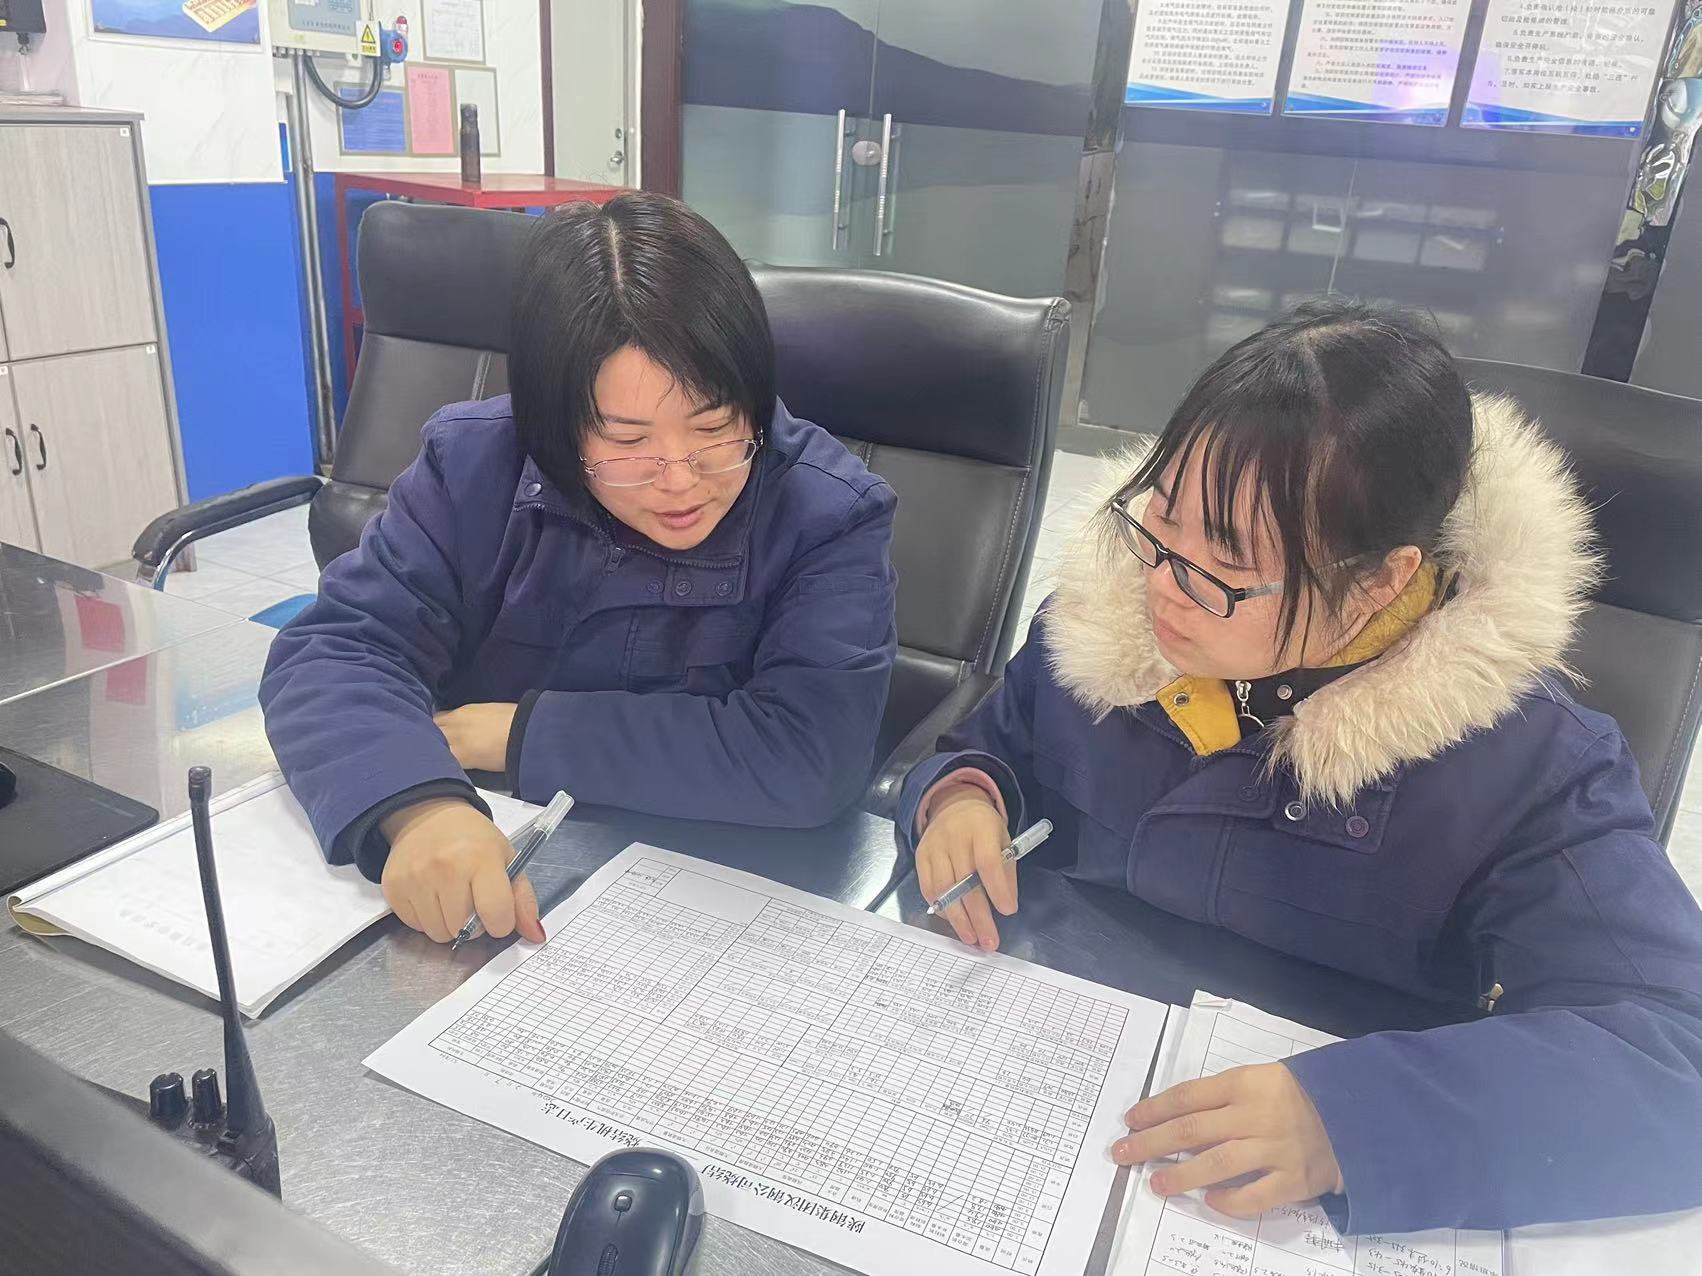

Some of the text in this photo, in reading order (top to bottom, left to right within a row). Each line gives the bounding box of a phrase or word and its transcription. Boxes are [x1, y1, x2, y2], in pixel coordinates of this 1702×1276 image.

[542, 1104, 865, 1234] 陕钢集团汉钢公司烧结厂 烧结机生产日志
